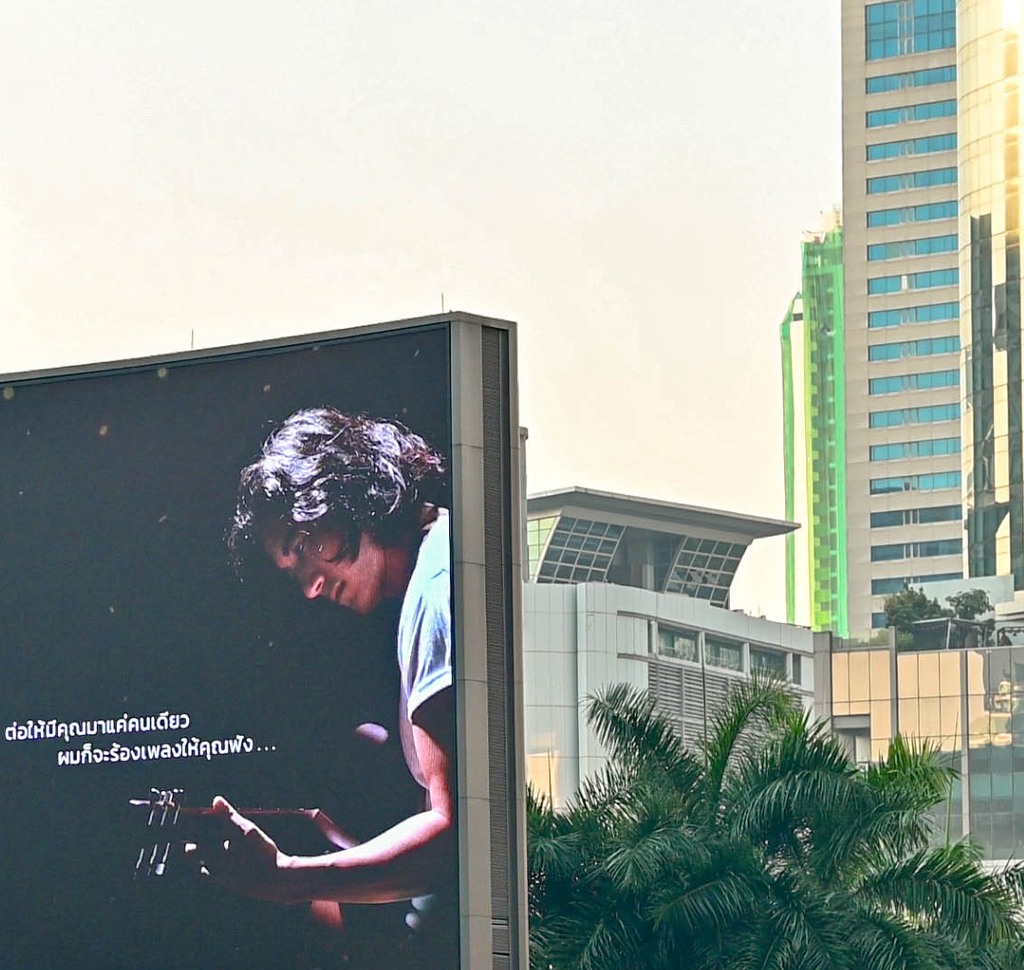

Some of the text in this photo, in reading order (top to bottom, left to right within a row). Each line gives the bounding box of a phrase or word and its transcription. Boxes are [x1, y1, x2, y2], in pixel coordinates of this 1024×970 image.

[4, 711, 190, 742] ต่อให้มีคุณมาแค่คนเดียว
